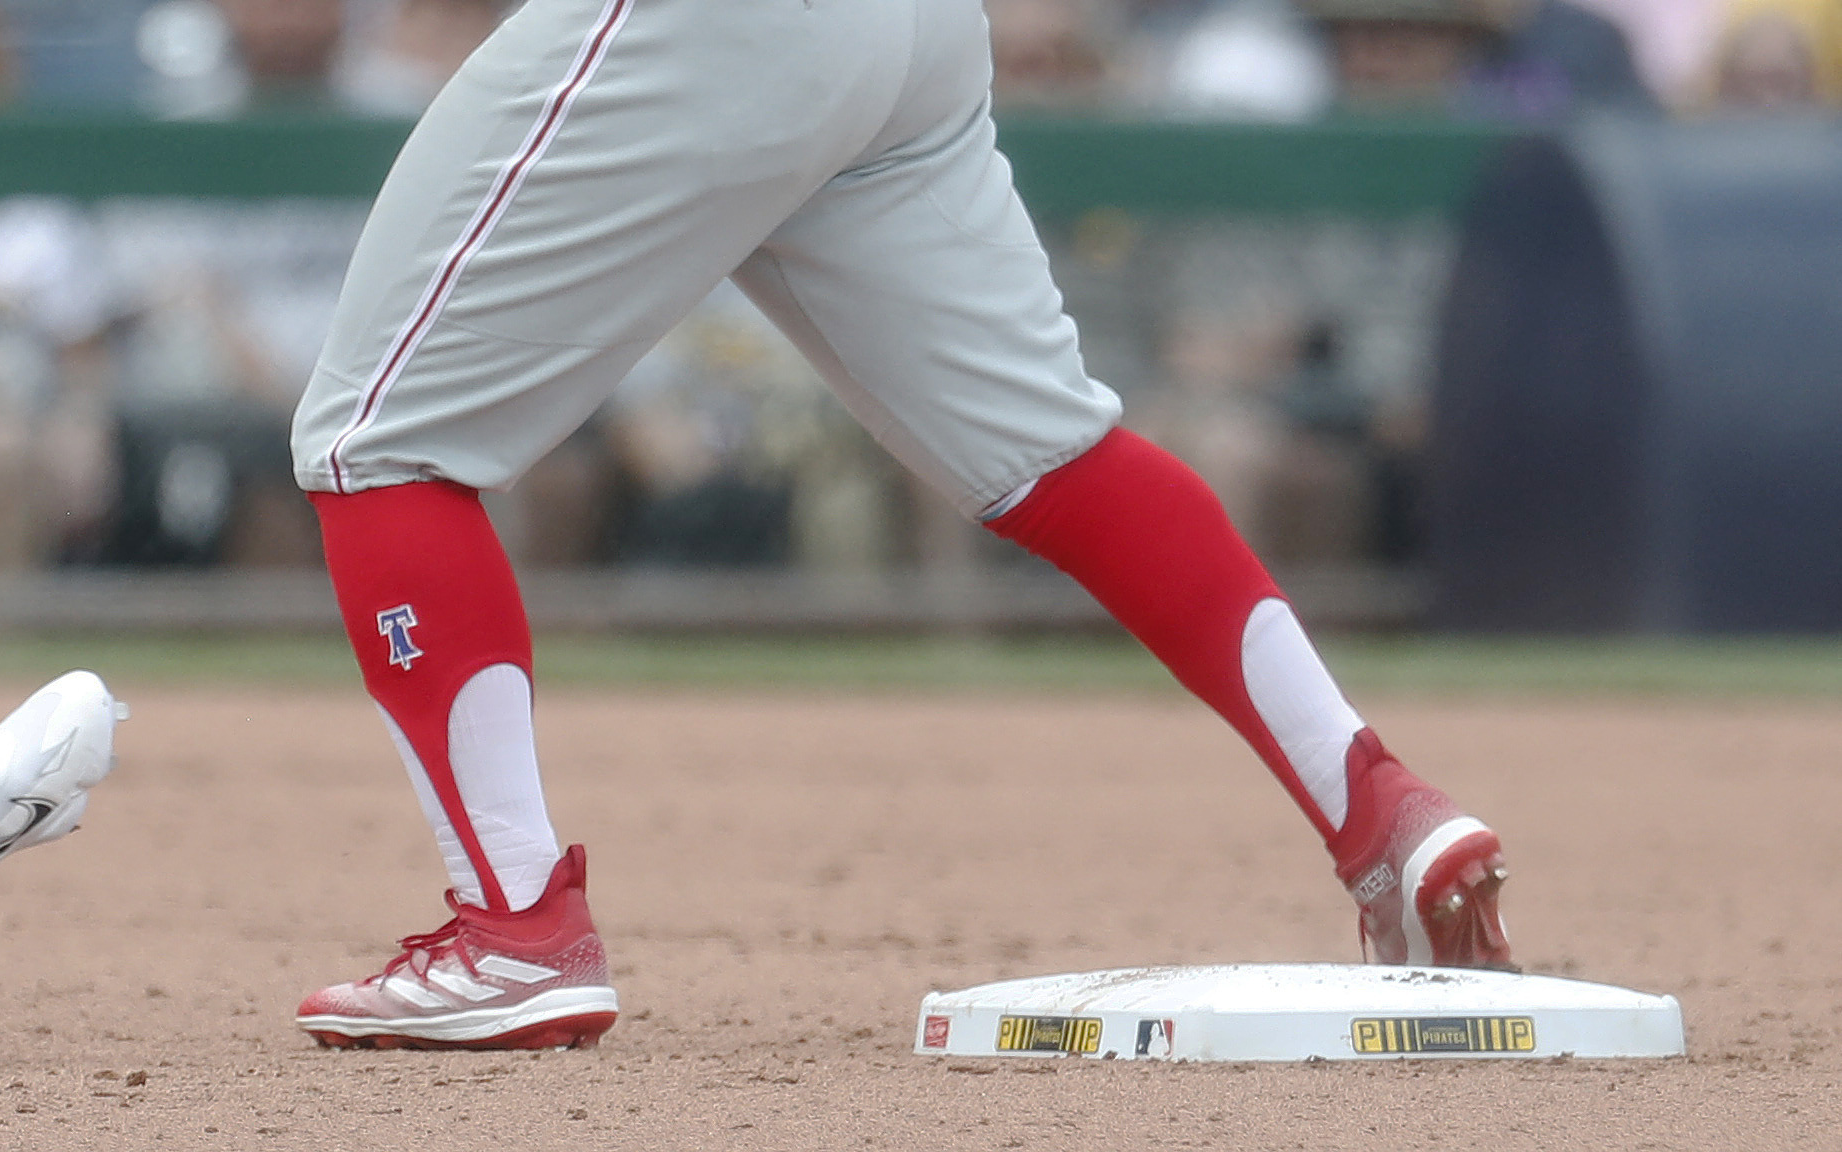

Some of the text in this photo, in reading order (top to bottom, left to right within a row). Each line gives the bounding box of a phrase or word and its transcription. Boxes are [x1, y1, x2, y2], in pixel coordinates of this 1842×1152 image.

[1358, 1021, 1529, 1051] P PIRATES P
